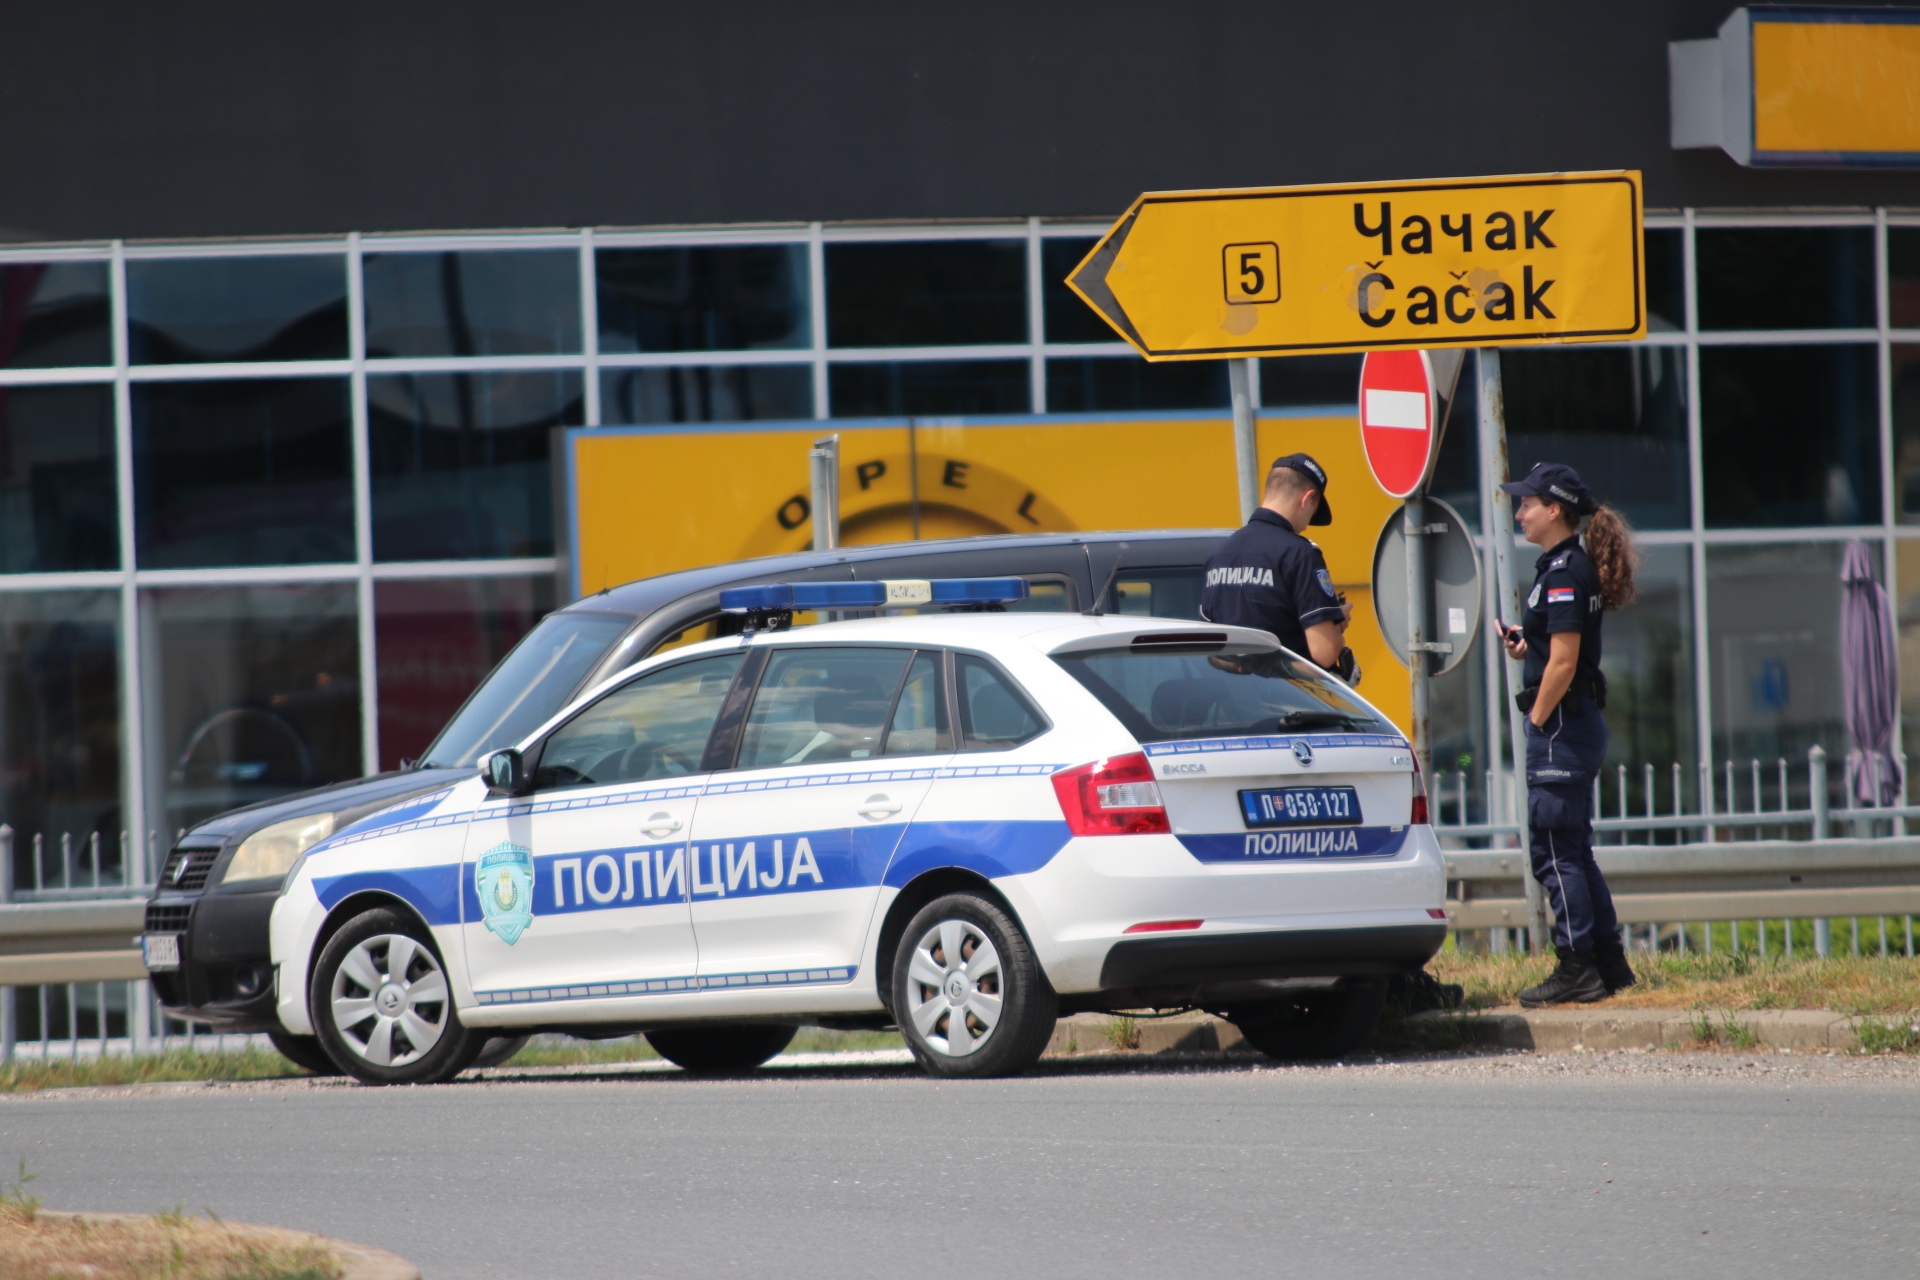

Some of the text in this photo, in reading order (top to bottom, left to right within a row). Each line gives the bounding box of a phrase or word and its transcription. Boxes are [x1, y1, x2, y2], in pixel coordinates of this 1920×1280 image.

[1353, 201, 1558, 256] Чачак
[1240, 252, 1265, 295] 5
[1356, 260, 1558, 328] Čačak
[777, 459, 1041, 530] OPEL
[1205, 566, 1275, 587] ПОЛИЦИЈА
[1244, 830, 1359, 856] ПОЛИЦИЈА
[552, 837, 824, 908] ПОЛИЦИЈА
